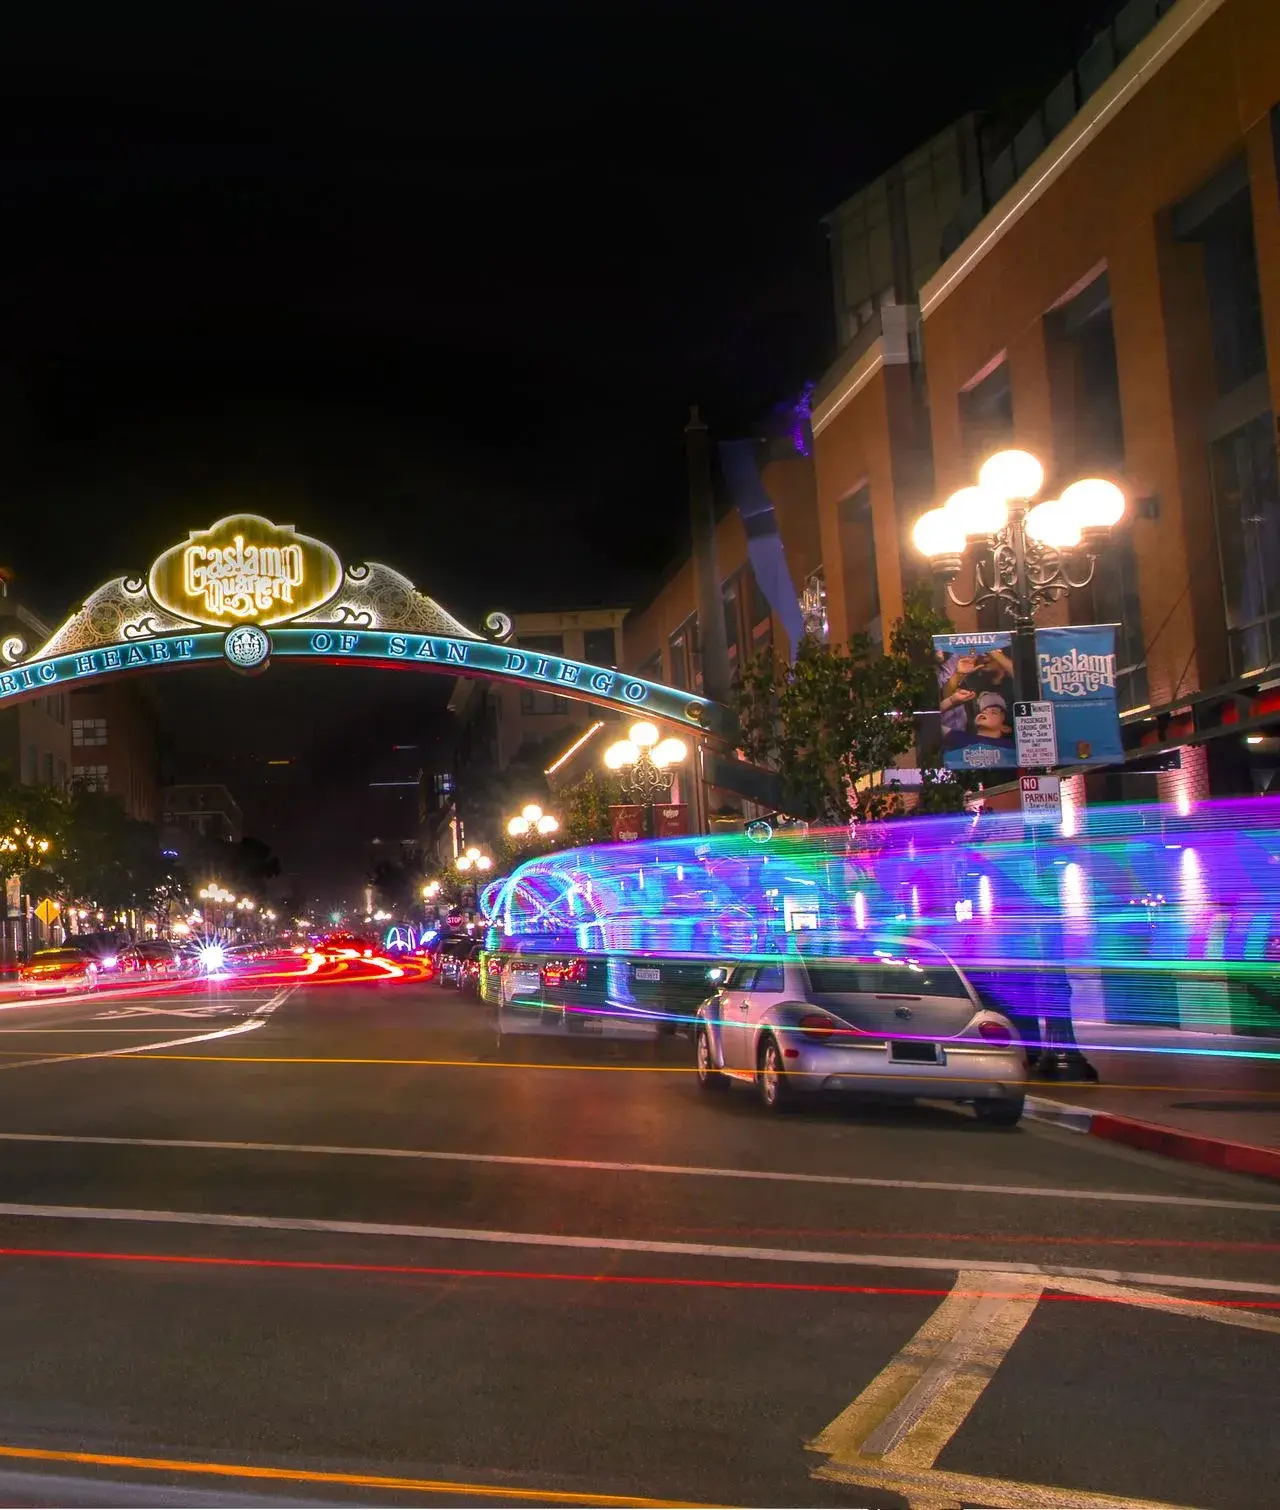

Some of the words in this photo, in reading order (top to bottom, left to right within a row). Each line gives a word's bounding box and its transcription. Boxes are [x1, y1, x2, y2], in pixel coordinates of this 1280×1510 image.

[183, 535, 303, 596] Gaslamp
[204, 574, 294, 617] Quarter
[948, 634, 997, 646] FAMILY
[75, 638, 194, 674] HEART
[312, 632, 359, 652] OF
[389, 635, 469, 662] SAN
[505, 651, 648, 702] DIEGO
[1020, 704, 1027, 716] 3
[1023, 778, 1037, 790] NO
[1024, 793, 1059, 803] PARKING
[447, 916, 462, 924] STOP
